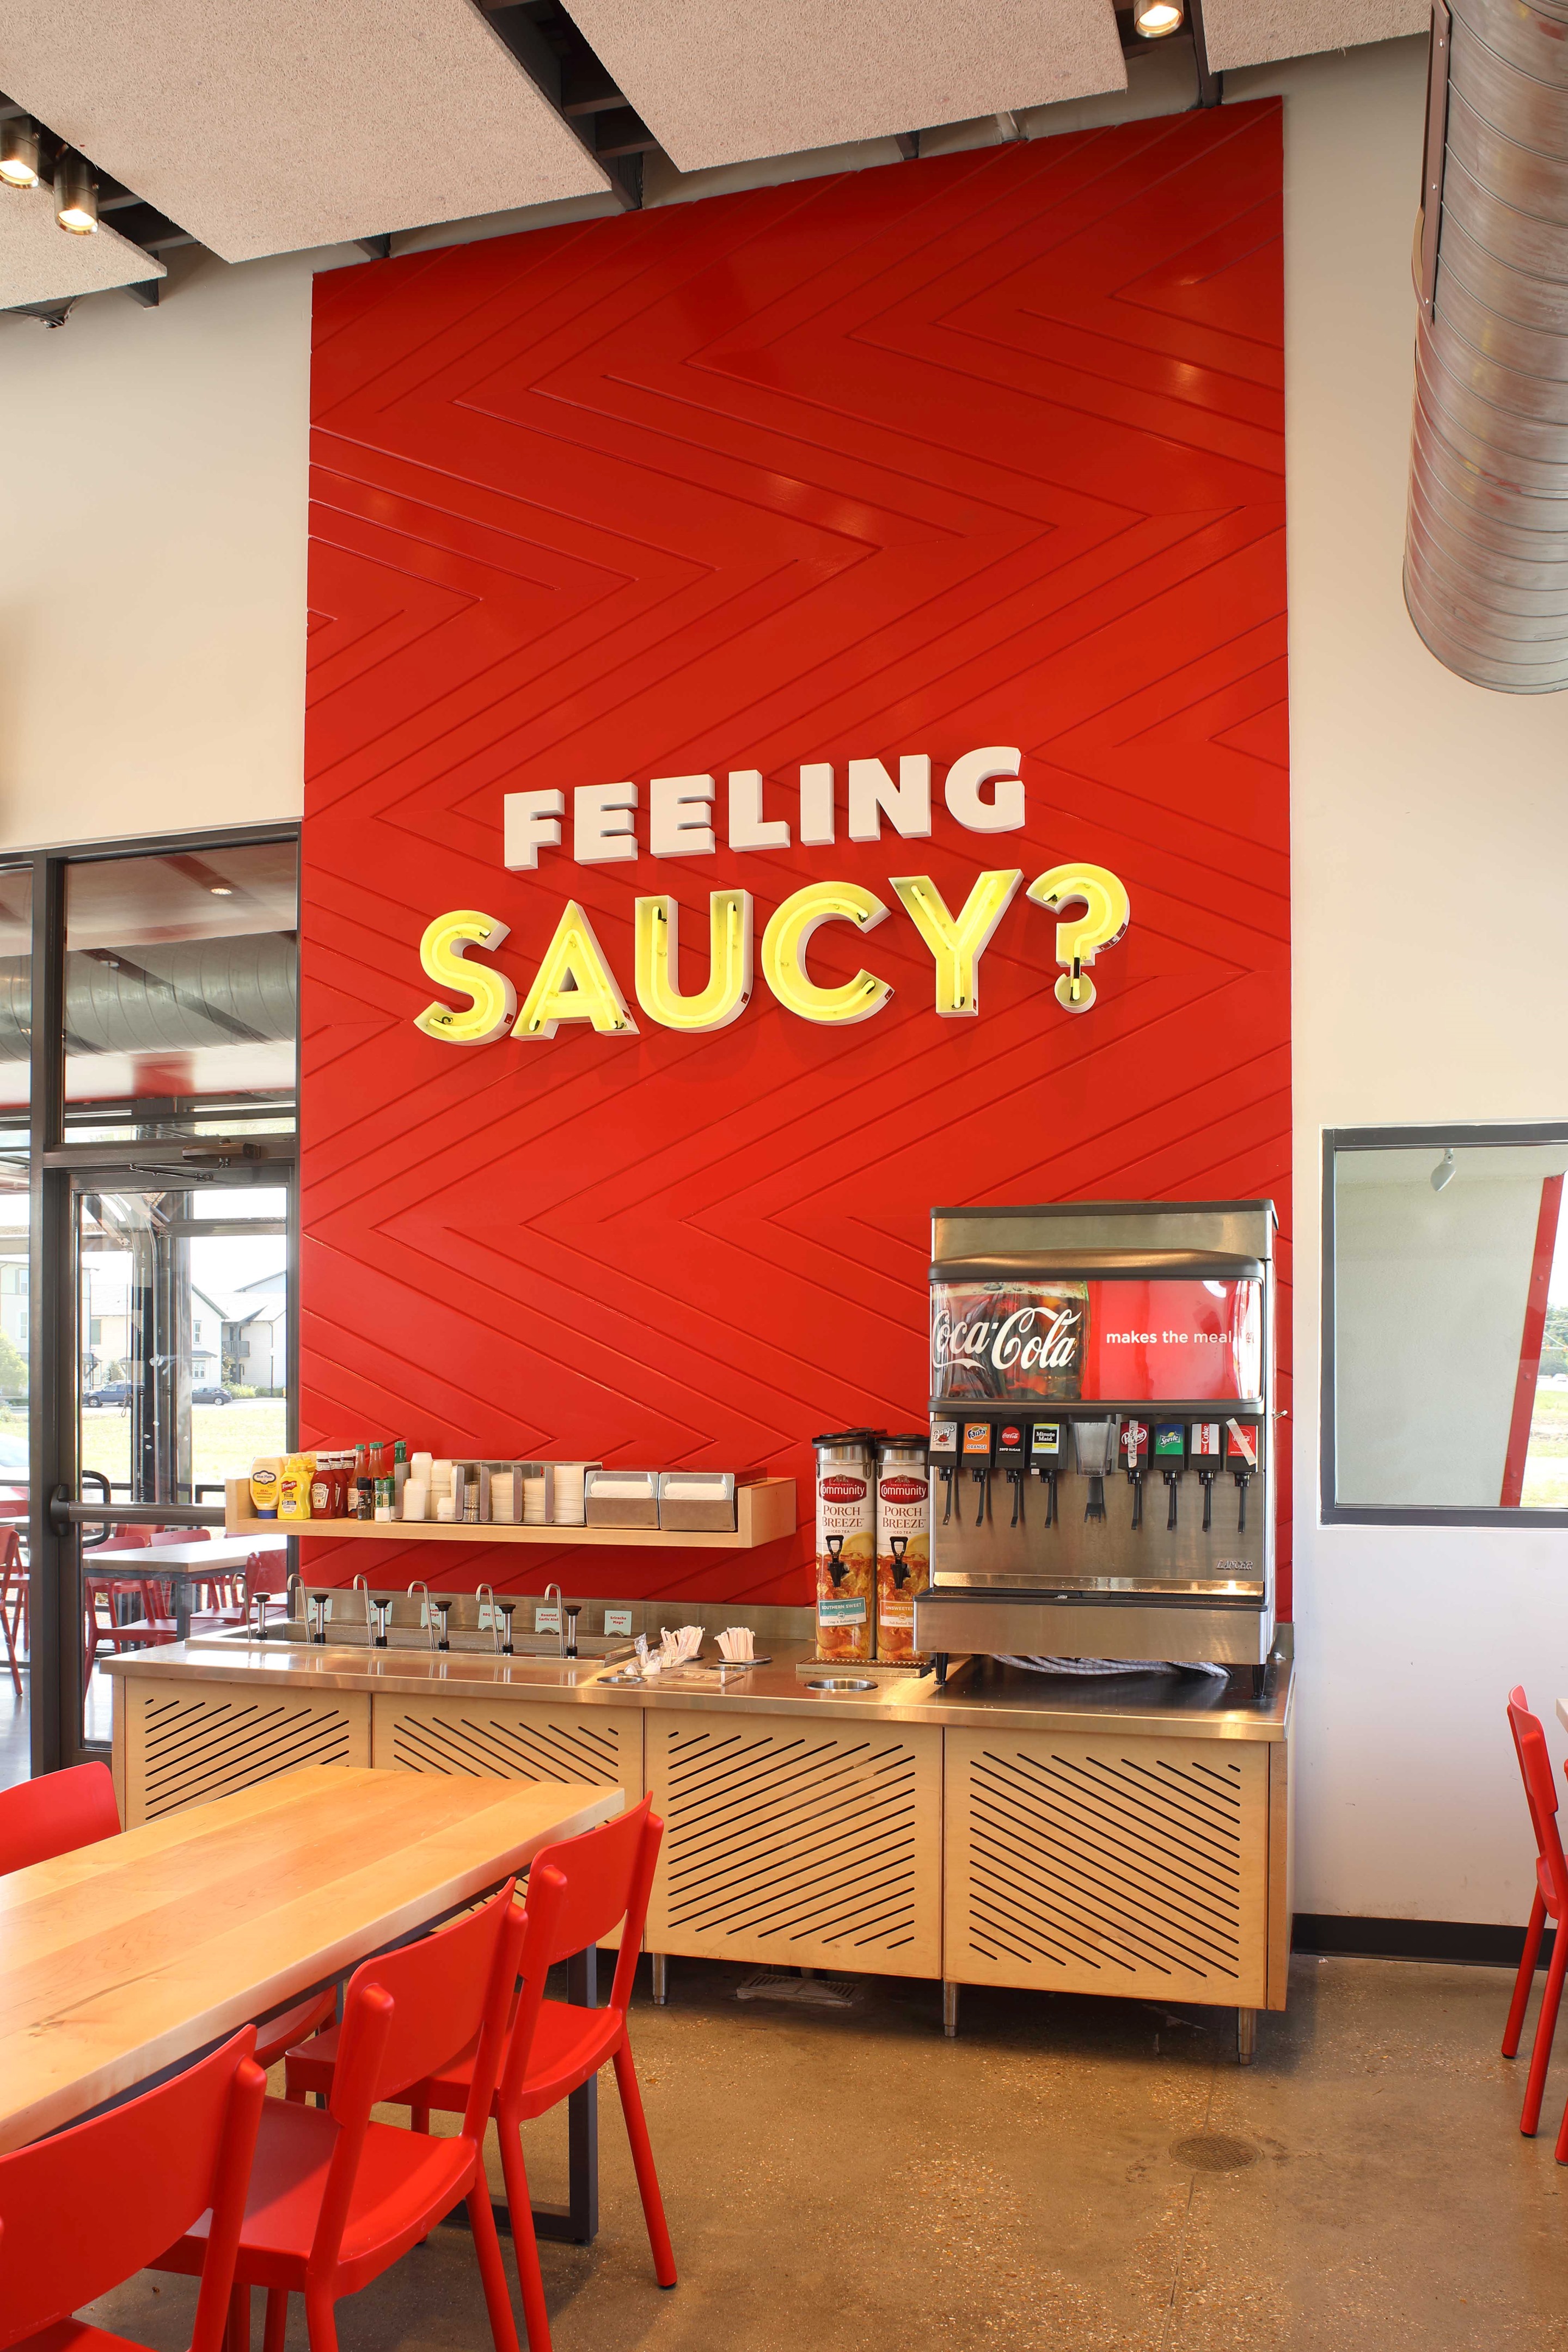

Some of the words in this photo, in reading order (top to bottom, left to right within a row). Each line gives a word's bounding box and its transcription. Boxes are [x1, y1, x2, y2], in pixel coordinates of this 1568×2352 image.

[503, 746, 1025, 871] FEELING
[413, 862, 1131, 1046] SAUCY?
[932, 1307, 1082, 1370] Coca-Cola
[1106, 1330, 1157, 1344] makes
[1162, 1330, 1189, 1344] the
[1193, 1330, 1232, 1344] meal
[932, 1425, 955, 1442] Barq's
[967, 1428, 985, 1438] Fanta
[1201, 1425, 1209, 1444] Coke
[1160, 1435, 1178, 1445] Sprite
[282, 1481, 296, 1490] French's
[820, 1484, 865, 1497] Community
[881, 1485, 926, 1497] Community
[823, 1505, 860, 1516] PORCH
[885, 1506, 922, 1517] PORCH
[822, 1517, 863, 1528] BREEZE
[883, 1517, 924, 1528] BREEZE
